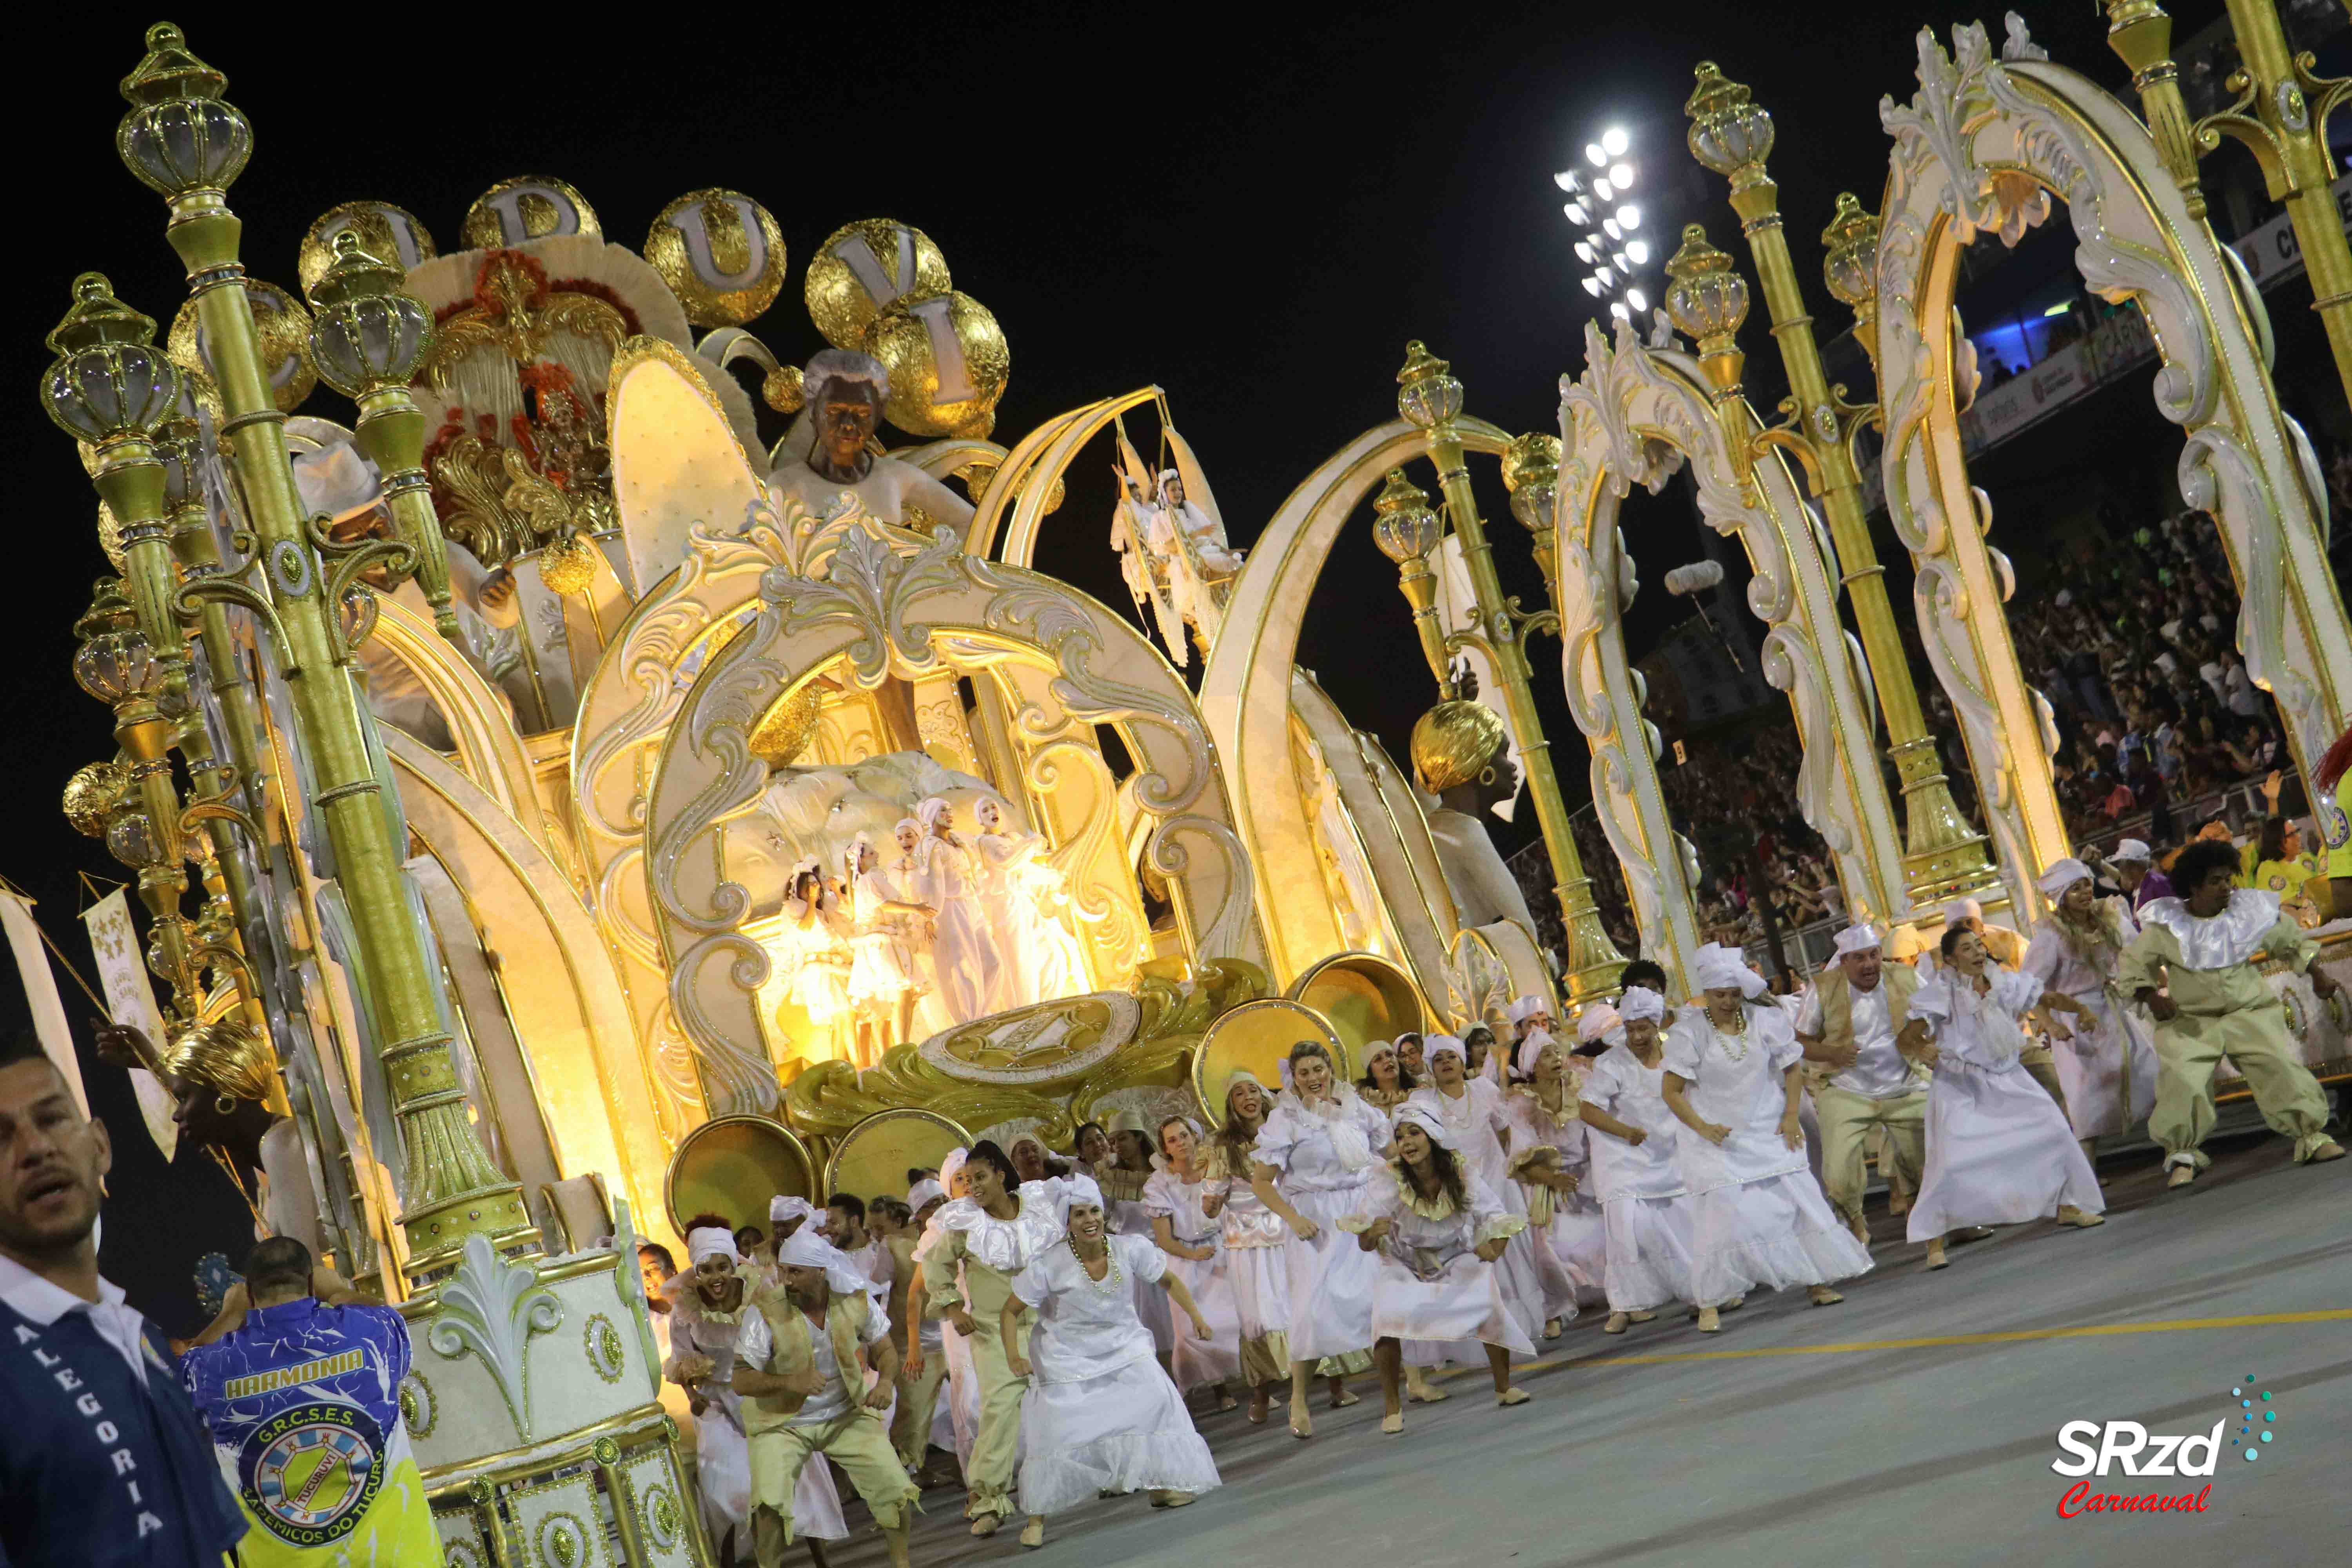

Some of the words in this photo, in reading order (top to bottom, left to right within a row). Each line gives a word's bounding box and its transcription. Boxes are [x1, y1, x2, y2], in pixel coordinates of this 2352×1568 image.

[225, 1348, 365, 1400] HARMONIA
[13, 1324, 163, 1538] ALEGORIA
[259, 1407, 354, 1443] G.R.C.S.E.S.
[297, 1454, 337, 1504] TUCURUVI
[328, 1517, 353, 1537] DO
